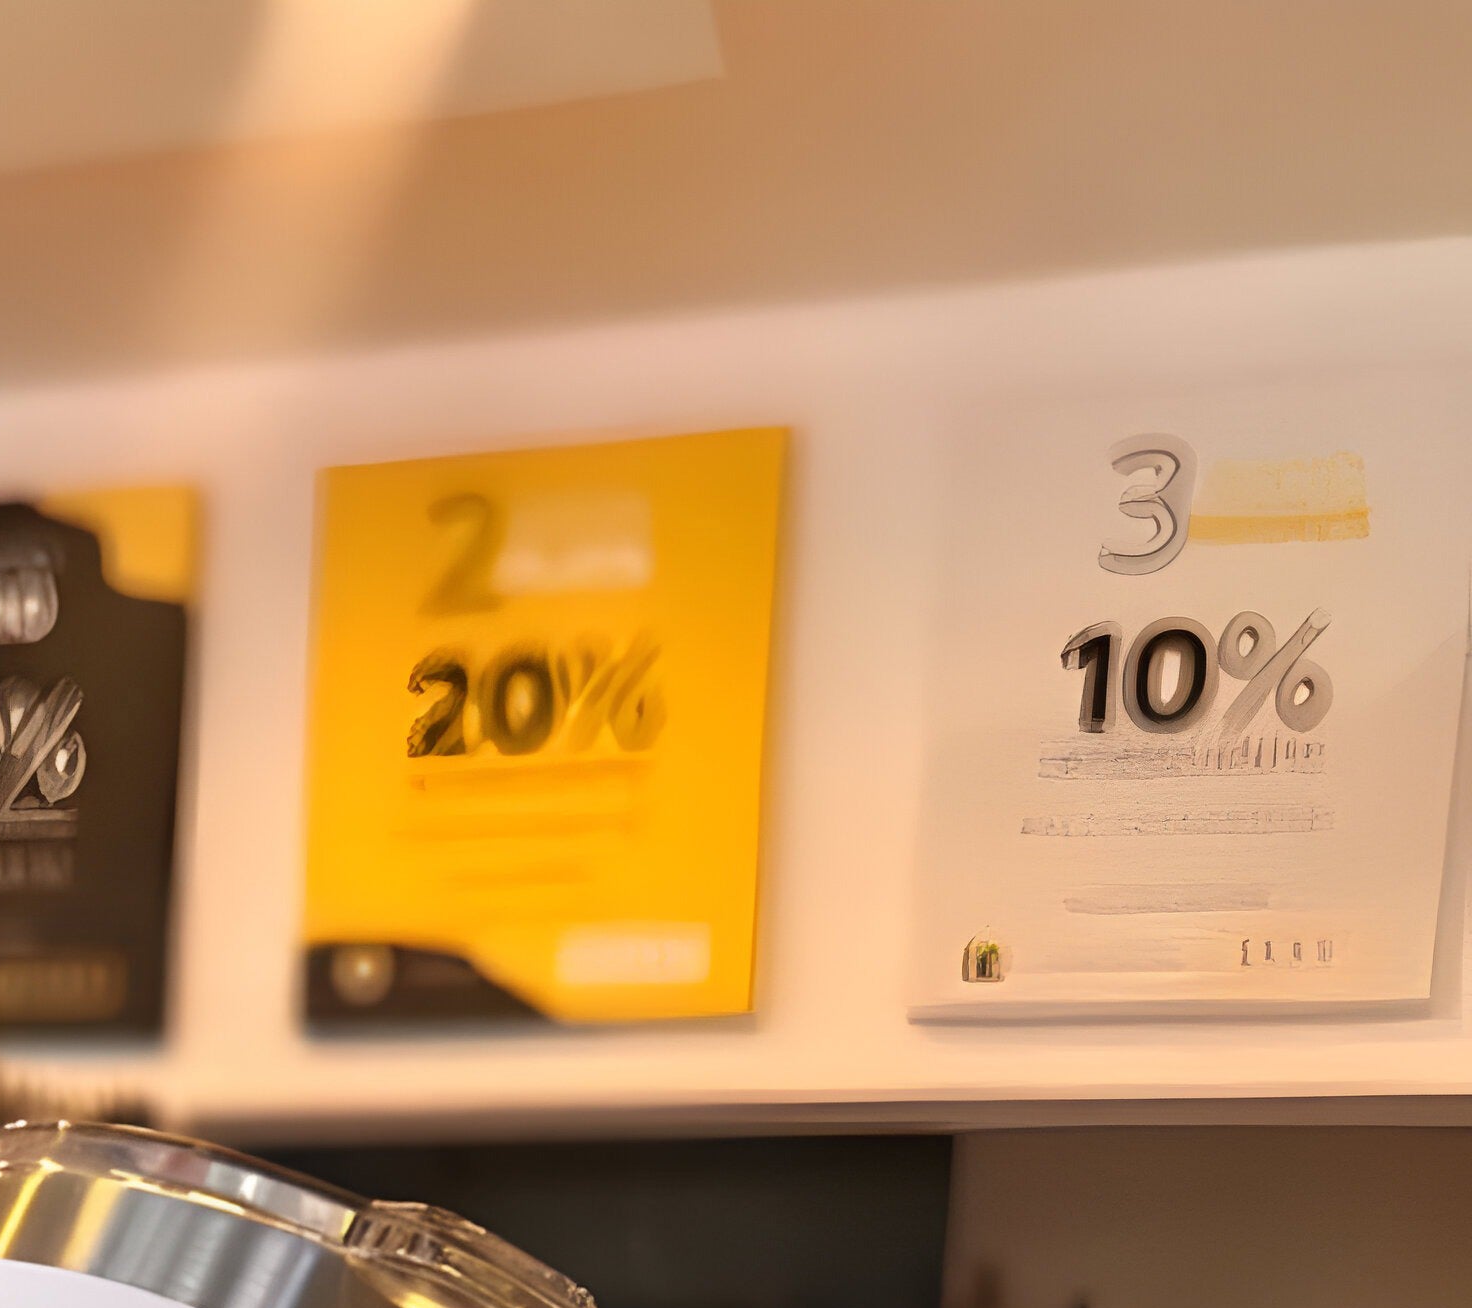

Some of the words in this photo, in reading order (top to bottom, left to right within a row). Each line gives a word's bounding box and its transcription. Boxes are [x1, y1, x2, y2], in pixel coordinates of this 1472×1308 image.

[416, 491, 506, 617] 2
[1099, 433, 1197, 575] 3
[406, 635, 667, 758] 20%
[1061, 607, 1334, 740] 10%
